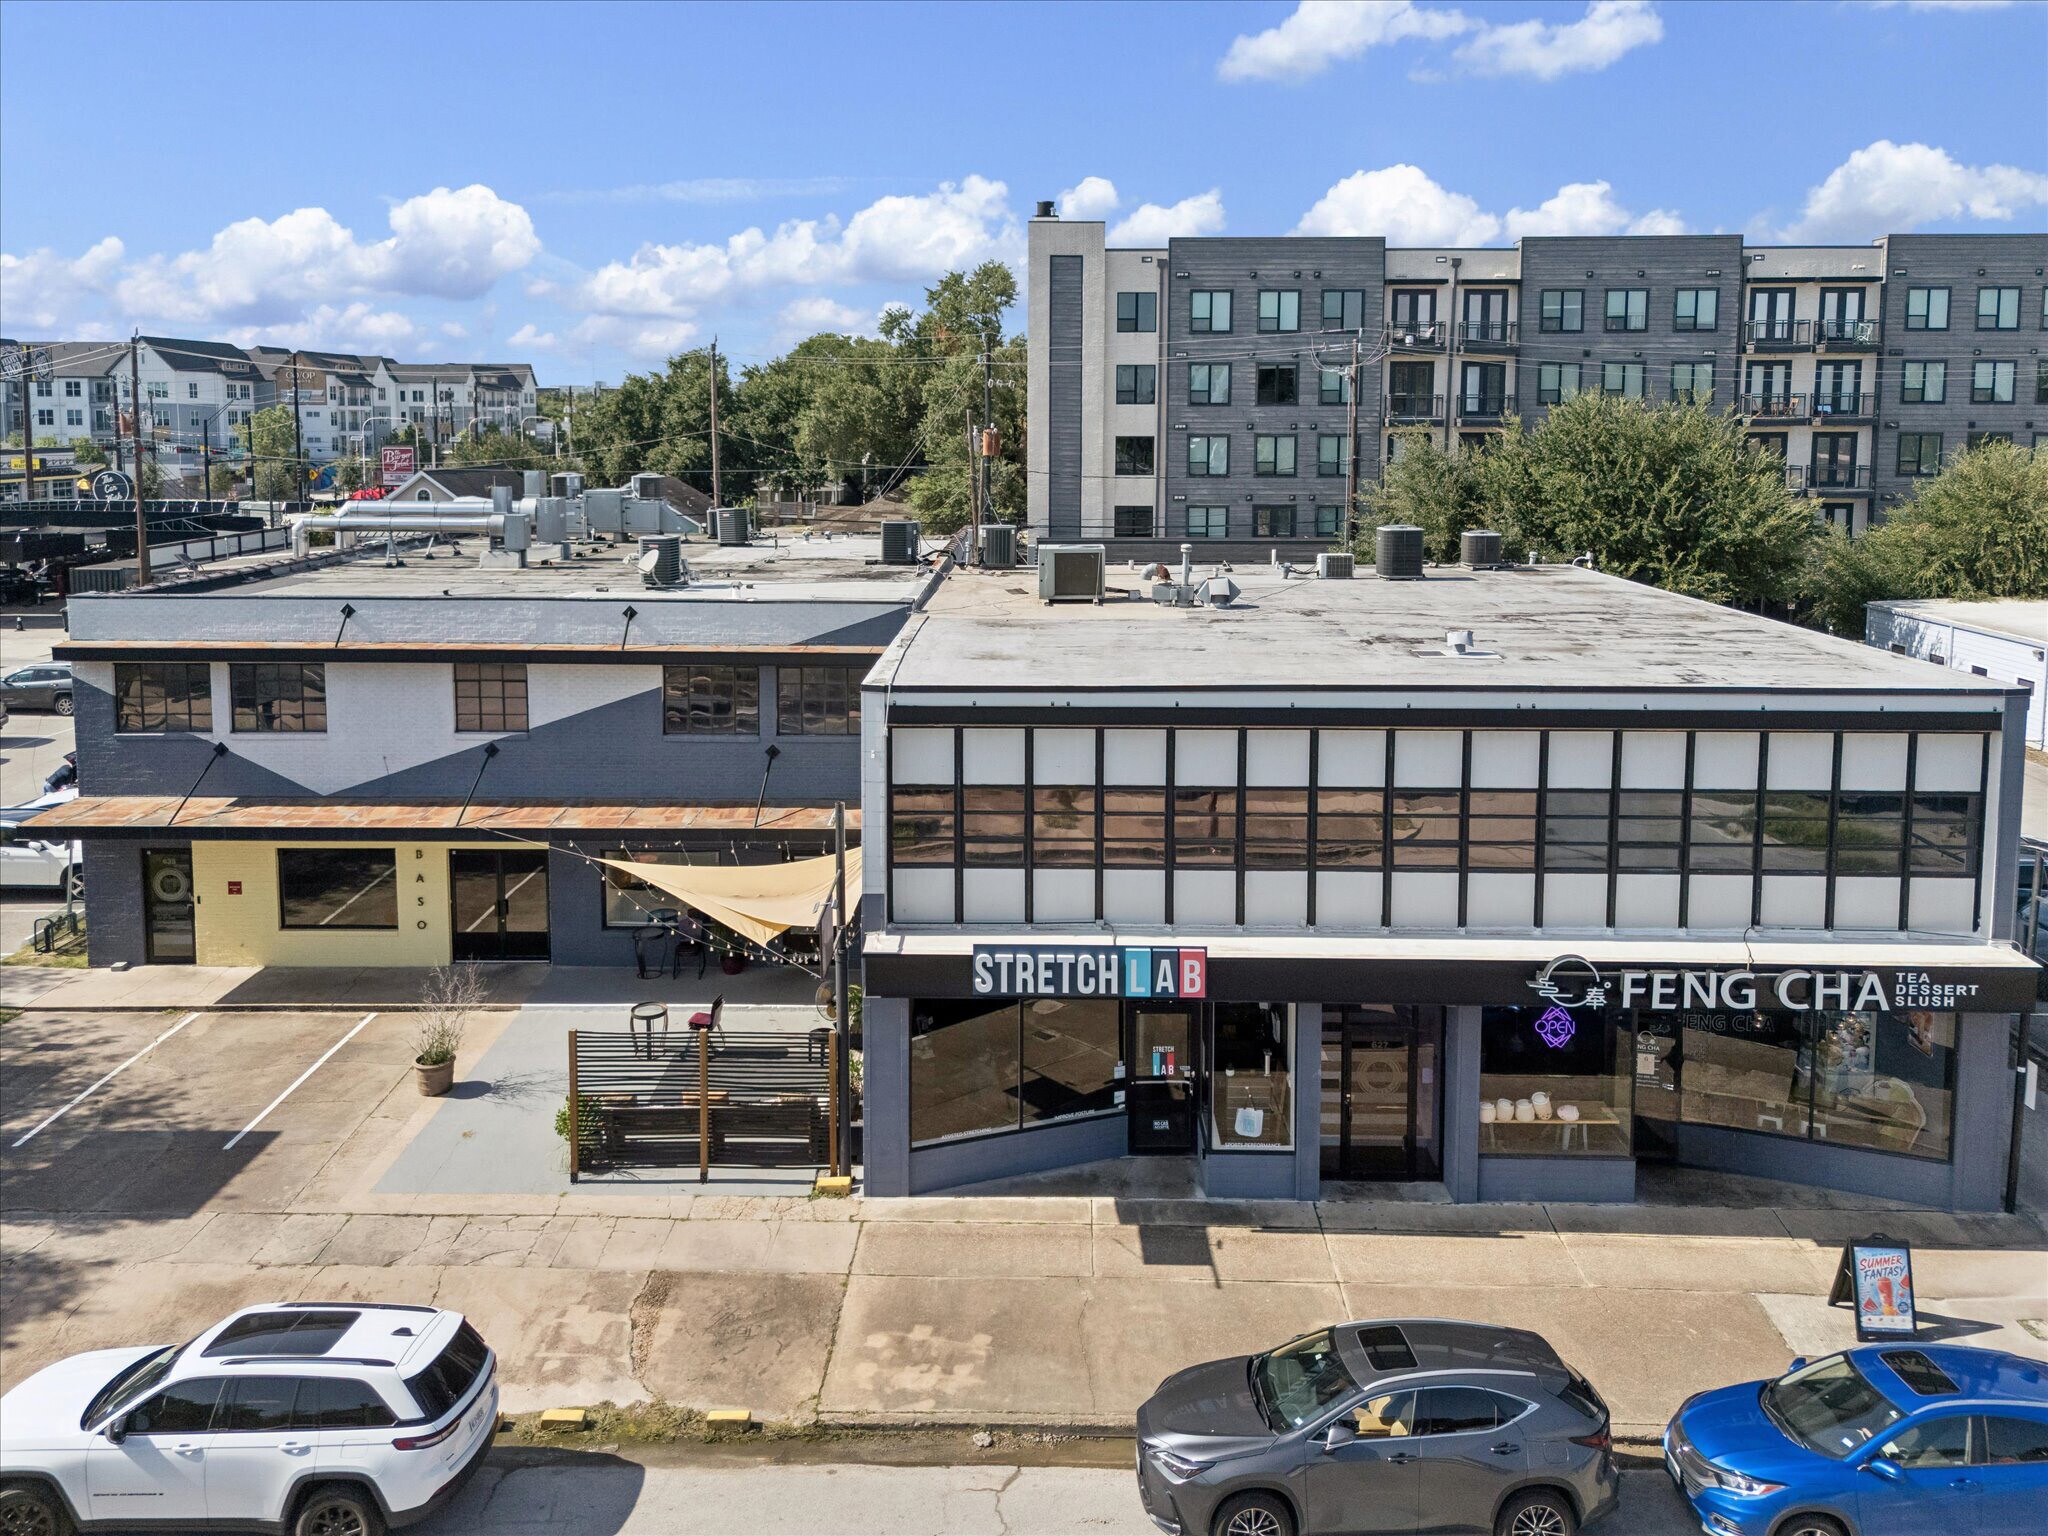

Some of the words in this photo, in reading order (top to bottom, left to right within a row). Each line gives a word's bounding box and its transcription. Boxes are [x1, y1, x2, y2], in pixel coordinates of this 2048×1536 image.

[384, 450, 412, 464] Burger
[101, 474, 114, 485] The
[416, 849, 427, 930] BASO
[1895, 972, 1930, 984] TEA
[1622, 972, 1756, 1010] FENG
[1778, 972, 1891, 1011] CHA
[1895, 984, 1979, 996] DESSERT
[1895, 996, 1955, 1007] SLUSH
[1535, 1019, 1576, 1035] OPEN
[1153, 1045, 1175, 1053] STRETCH
[1154, 1065, 1175, 1076] LAB
[1860, 1254, 1903, 1271] SUMMER
[1864, 1265, 1906, 1282] FANTASY
